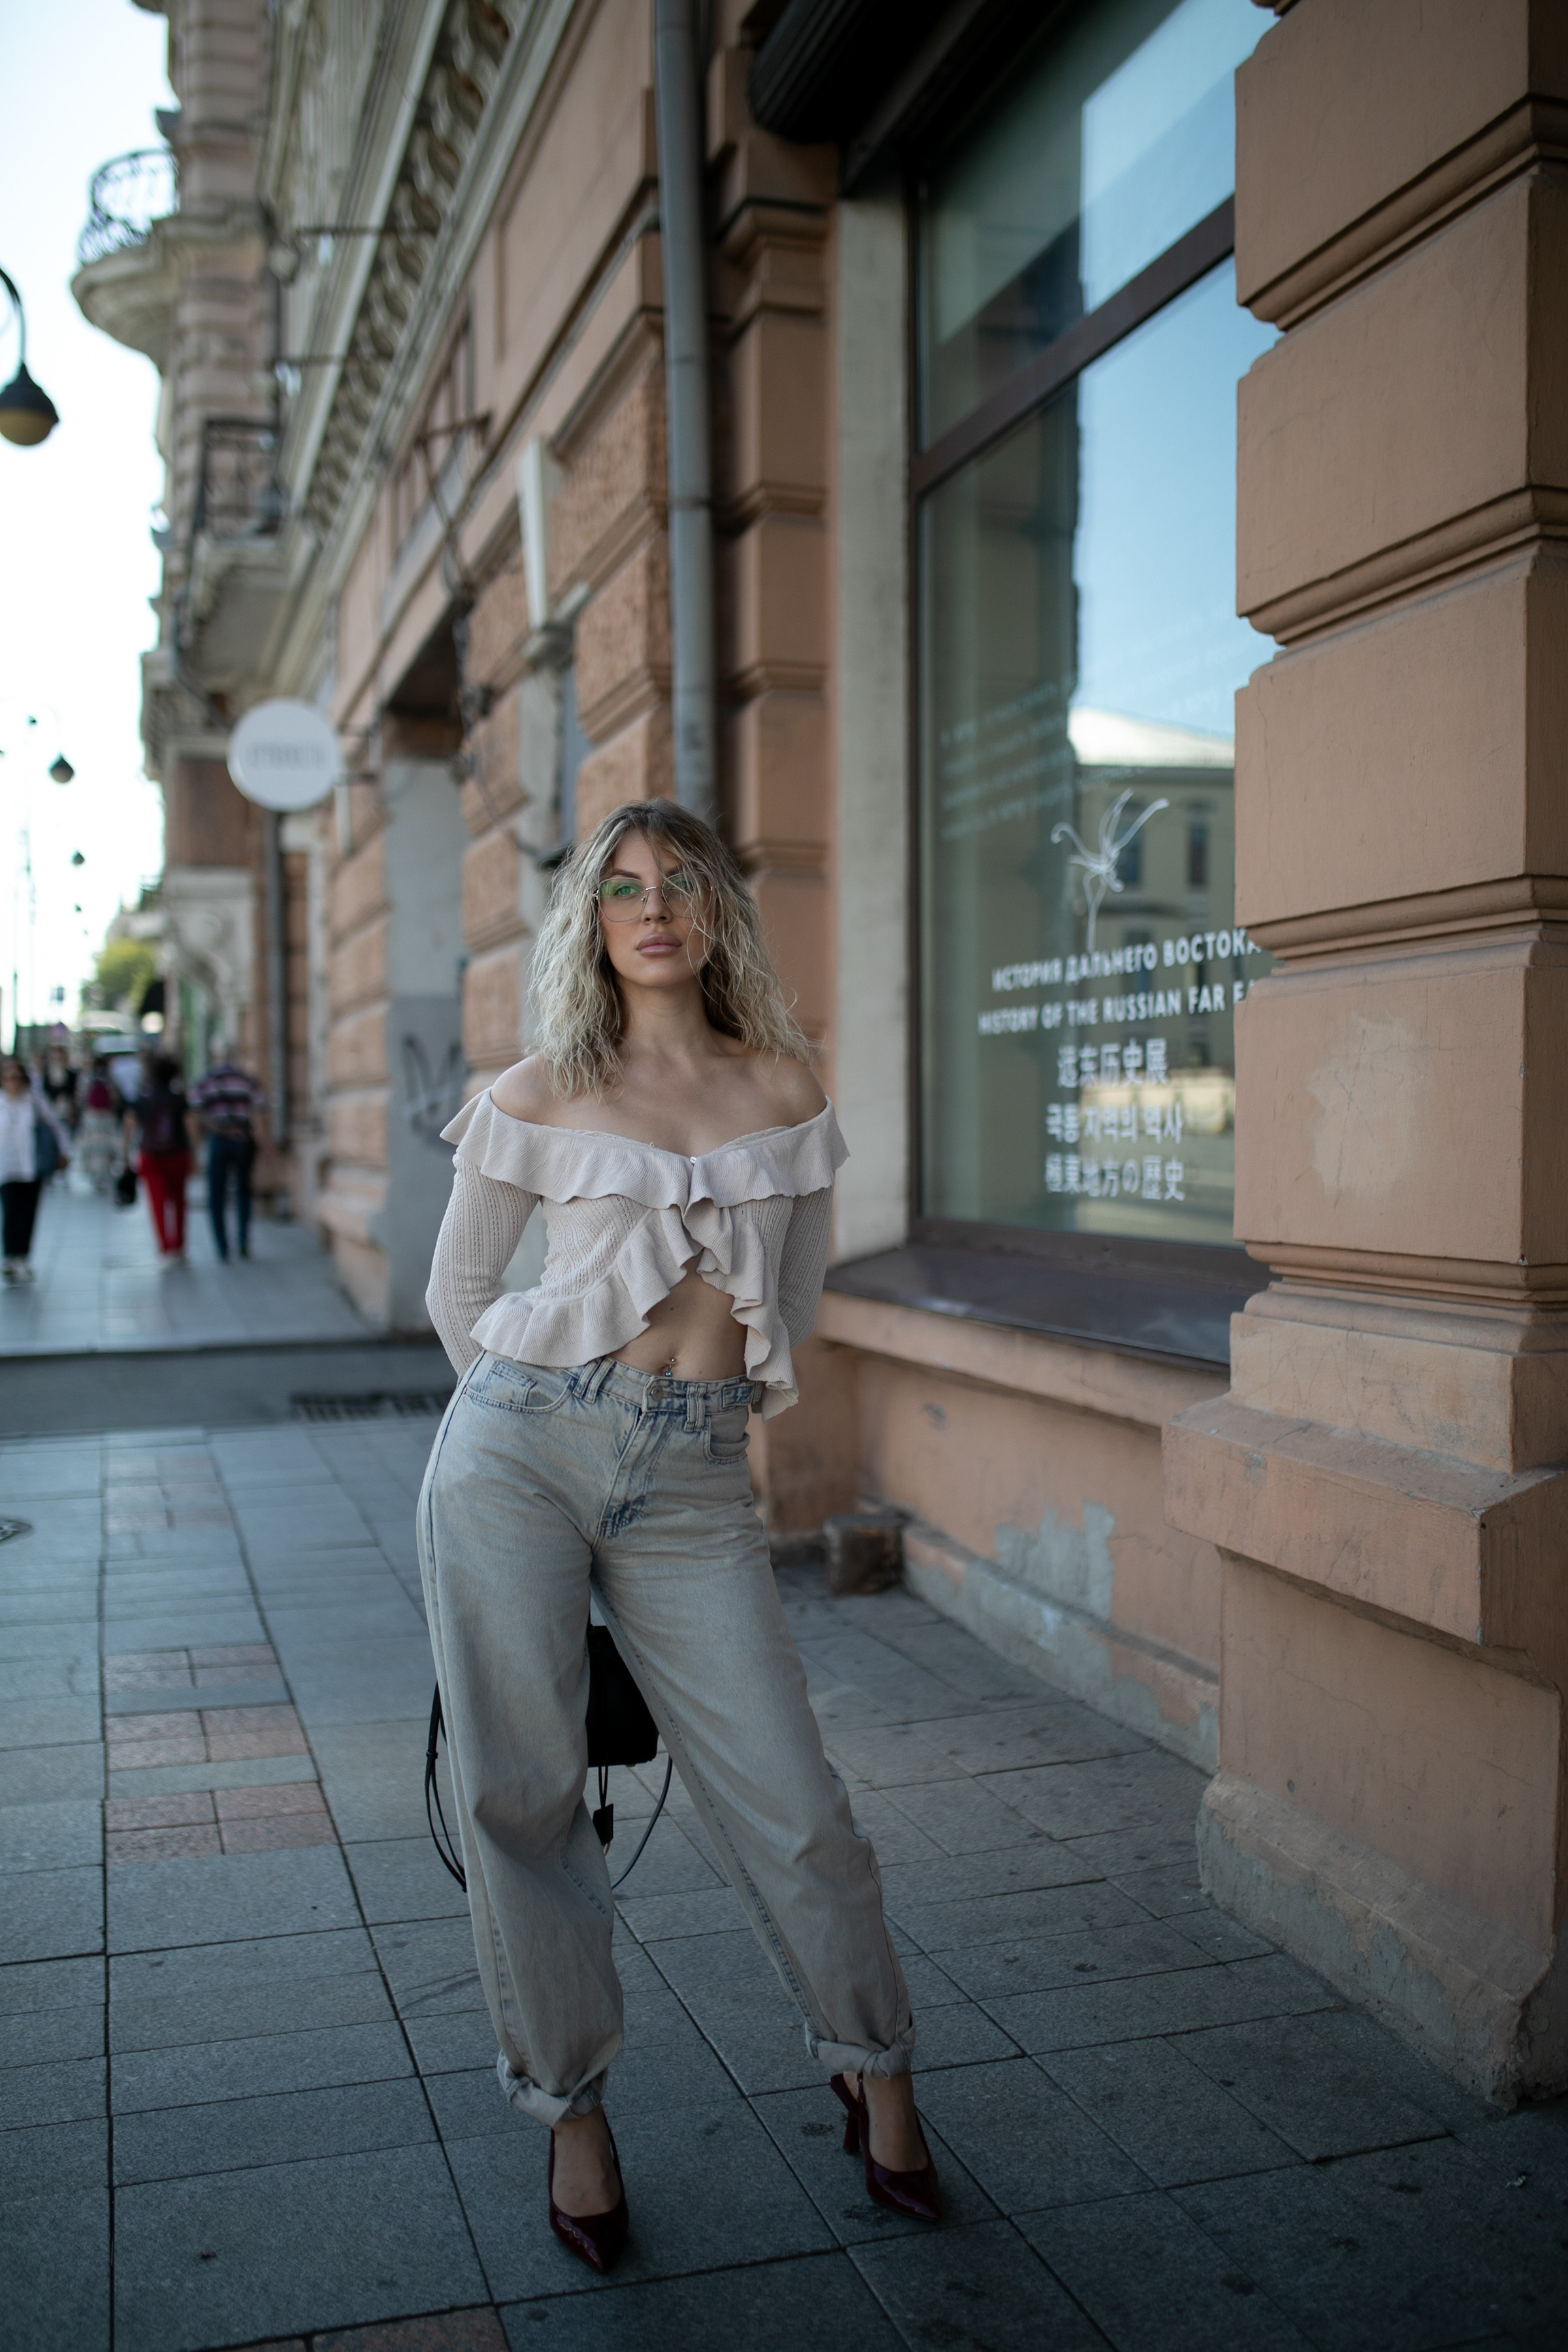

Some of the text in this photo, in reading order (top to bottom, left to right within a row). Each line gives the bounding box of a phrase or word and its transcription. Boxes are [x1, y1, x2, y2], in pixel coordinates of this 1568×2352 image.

[1065, 943, 1158, 986] ДАЛЬНЕГО
[979, 1005, 1039, 1035] HISTORY
[1041, 1001, 1064, 1030] OF
[1066, 997, 1099, 1027] THE
[1103, 987, 1182, 1023] RUSSIAN
[1188, 983, 1226, 1015] FAR
[1046, 1102, 1080, 1144] 극동
[1143, 1101, 1183, 1144] 역사
